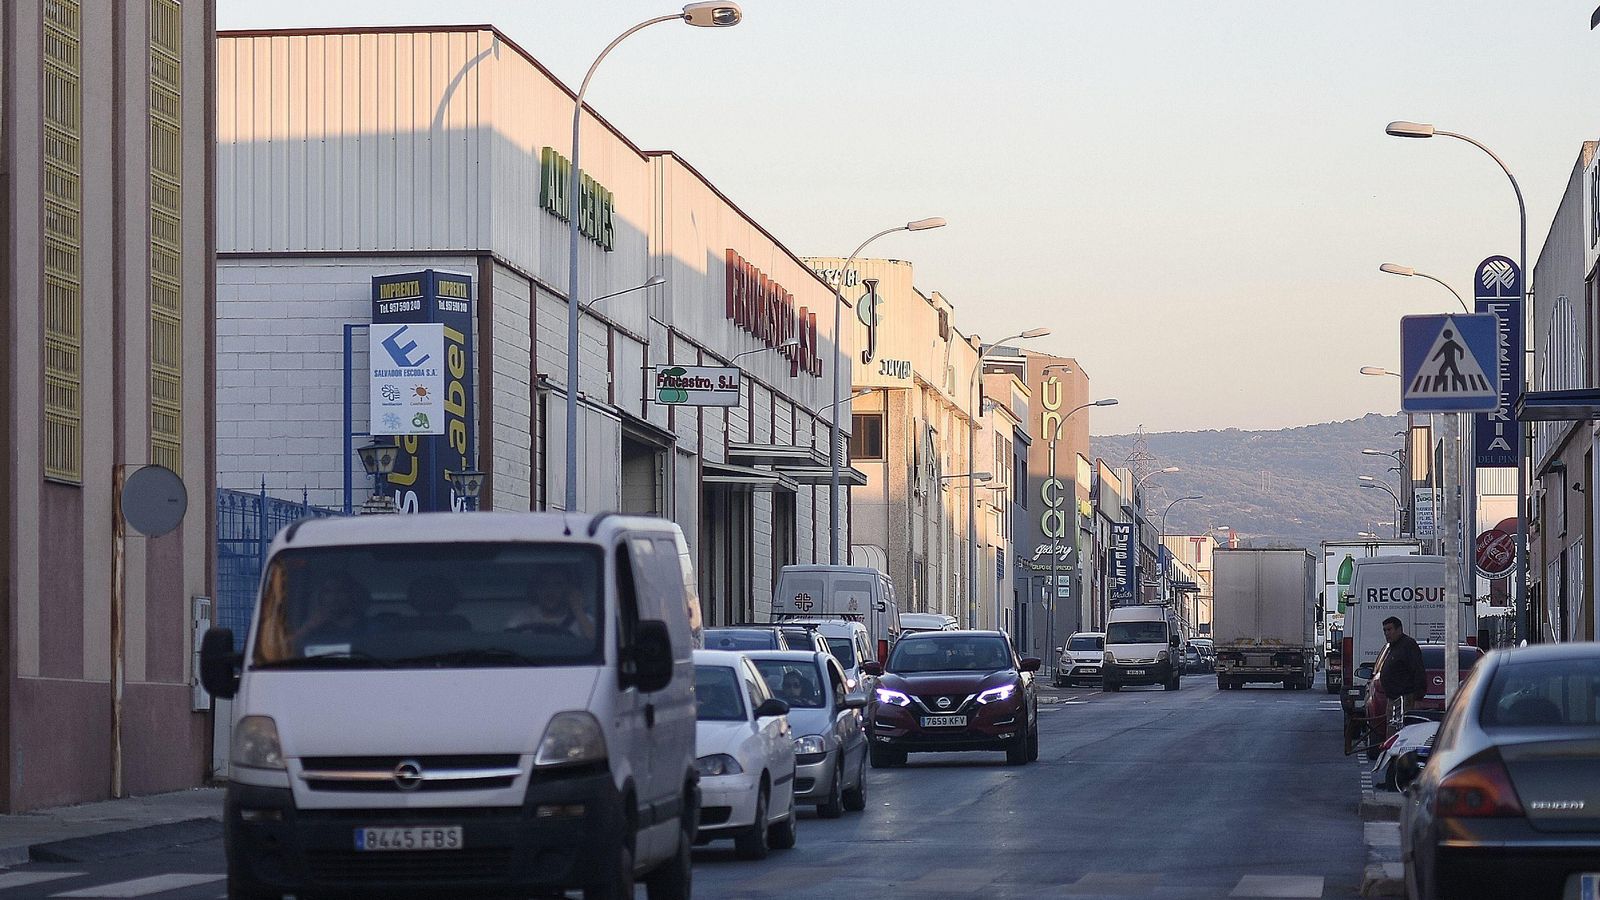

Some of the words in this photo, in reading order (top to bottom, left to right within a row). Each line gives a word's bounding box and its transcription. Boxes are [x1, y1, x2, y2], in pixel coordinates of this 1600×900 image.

[539, 147, 615, 252] ALMCENES
[380, 280, 420, 299] IMPRENTA
[438, 280, 467, 298] IMPRENTA
[374, 369, 402, 377] SALVADOR
[404, 369, 424, 377] ESCODA
[1498, 455, 1518, 464] PIN
[1114, 525, 1130, 585] MUEBLES
[926, 717, 947, 726] 7659
[949, 716, 965, 725] KFV
[366, 831, 415, 848] 8445
[421, 830, 457, 848] FBS
